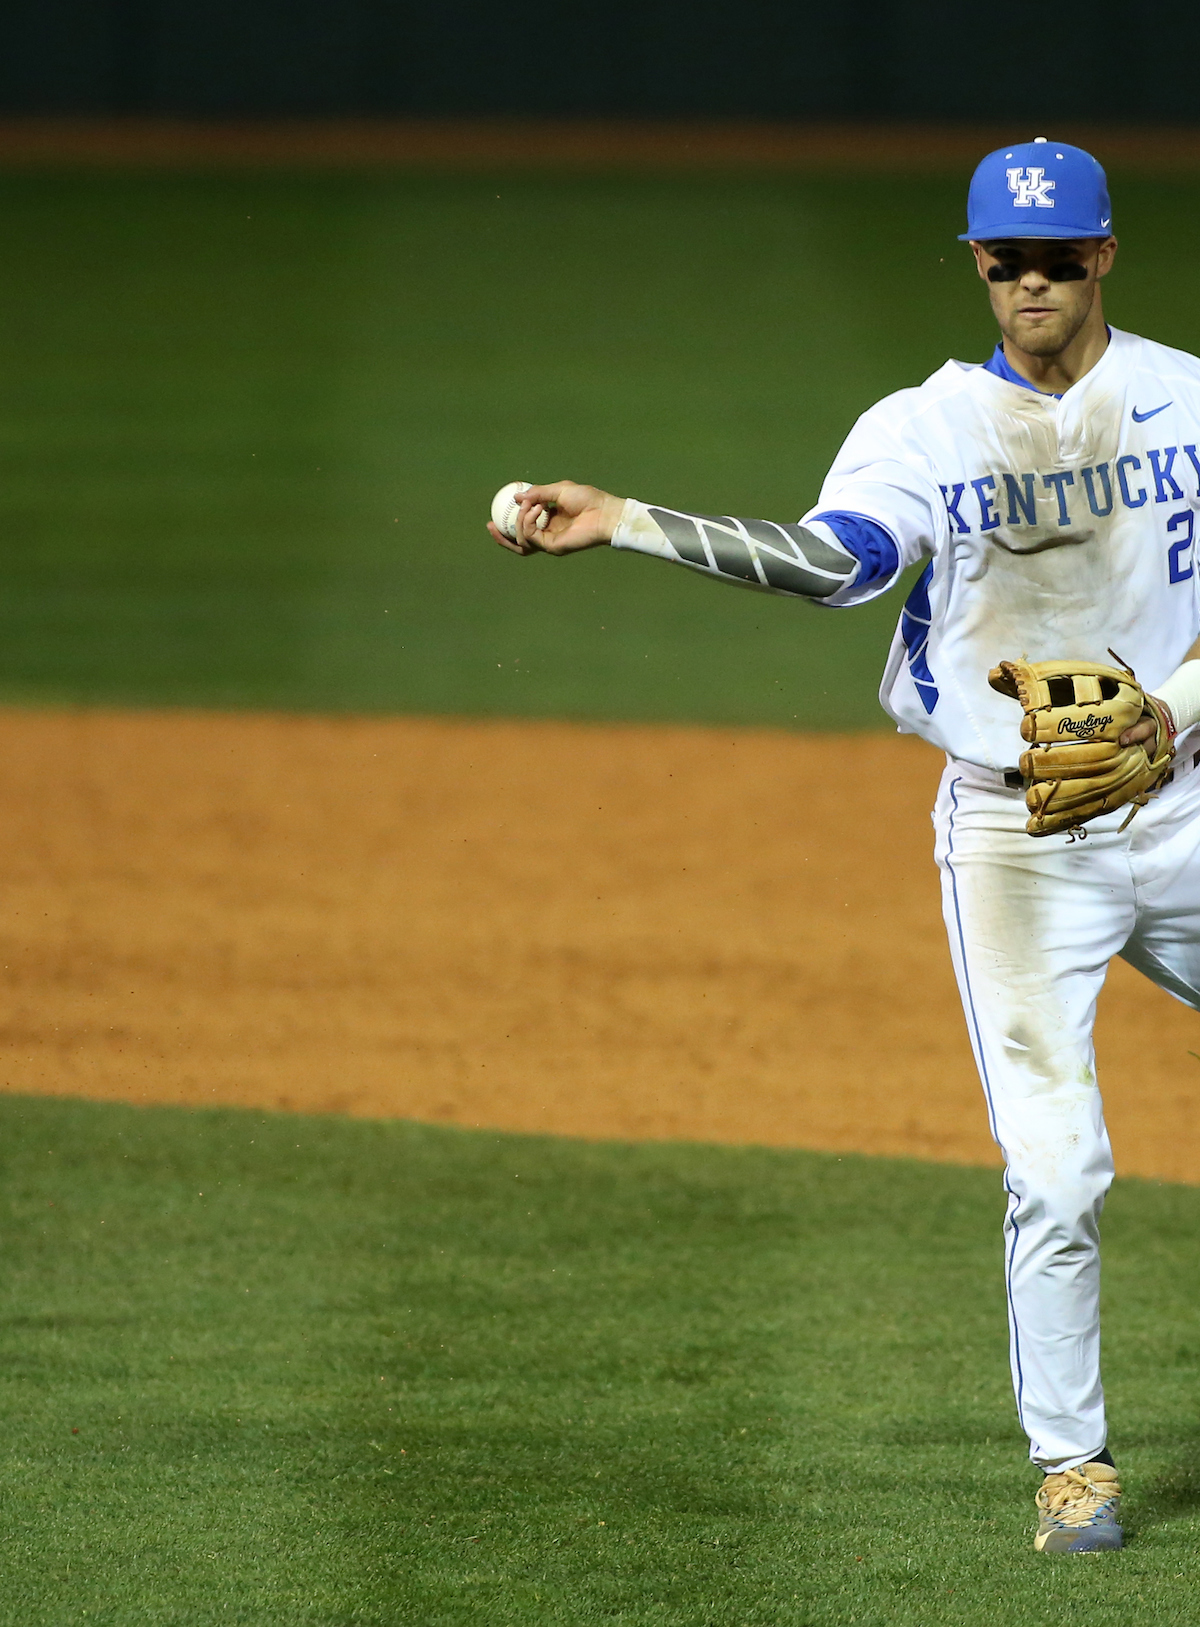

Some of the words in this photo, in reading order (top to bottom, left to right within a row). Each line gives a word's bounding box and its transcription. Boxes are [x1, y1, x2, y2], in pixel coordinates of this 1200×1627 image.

[1006, 167, 1056, 208] UK
[1166, 509, 1194, 585] 2
[1057, 713, 1114, 735] Rawlings
